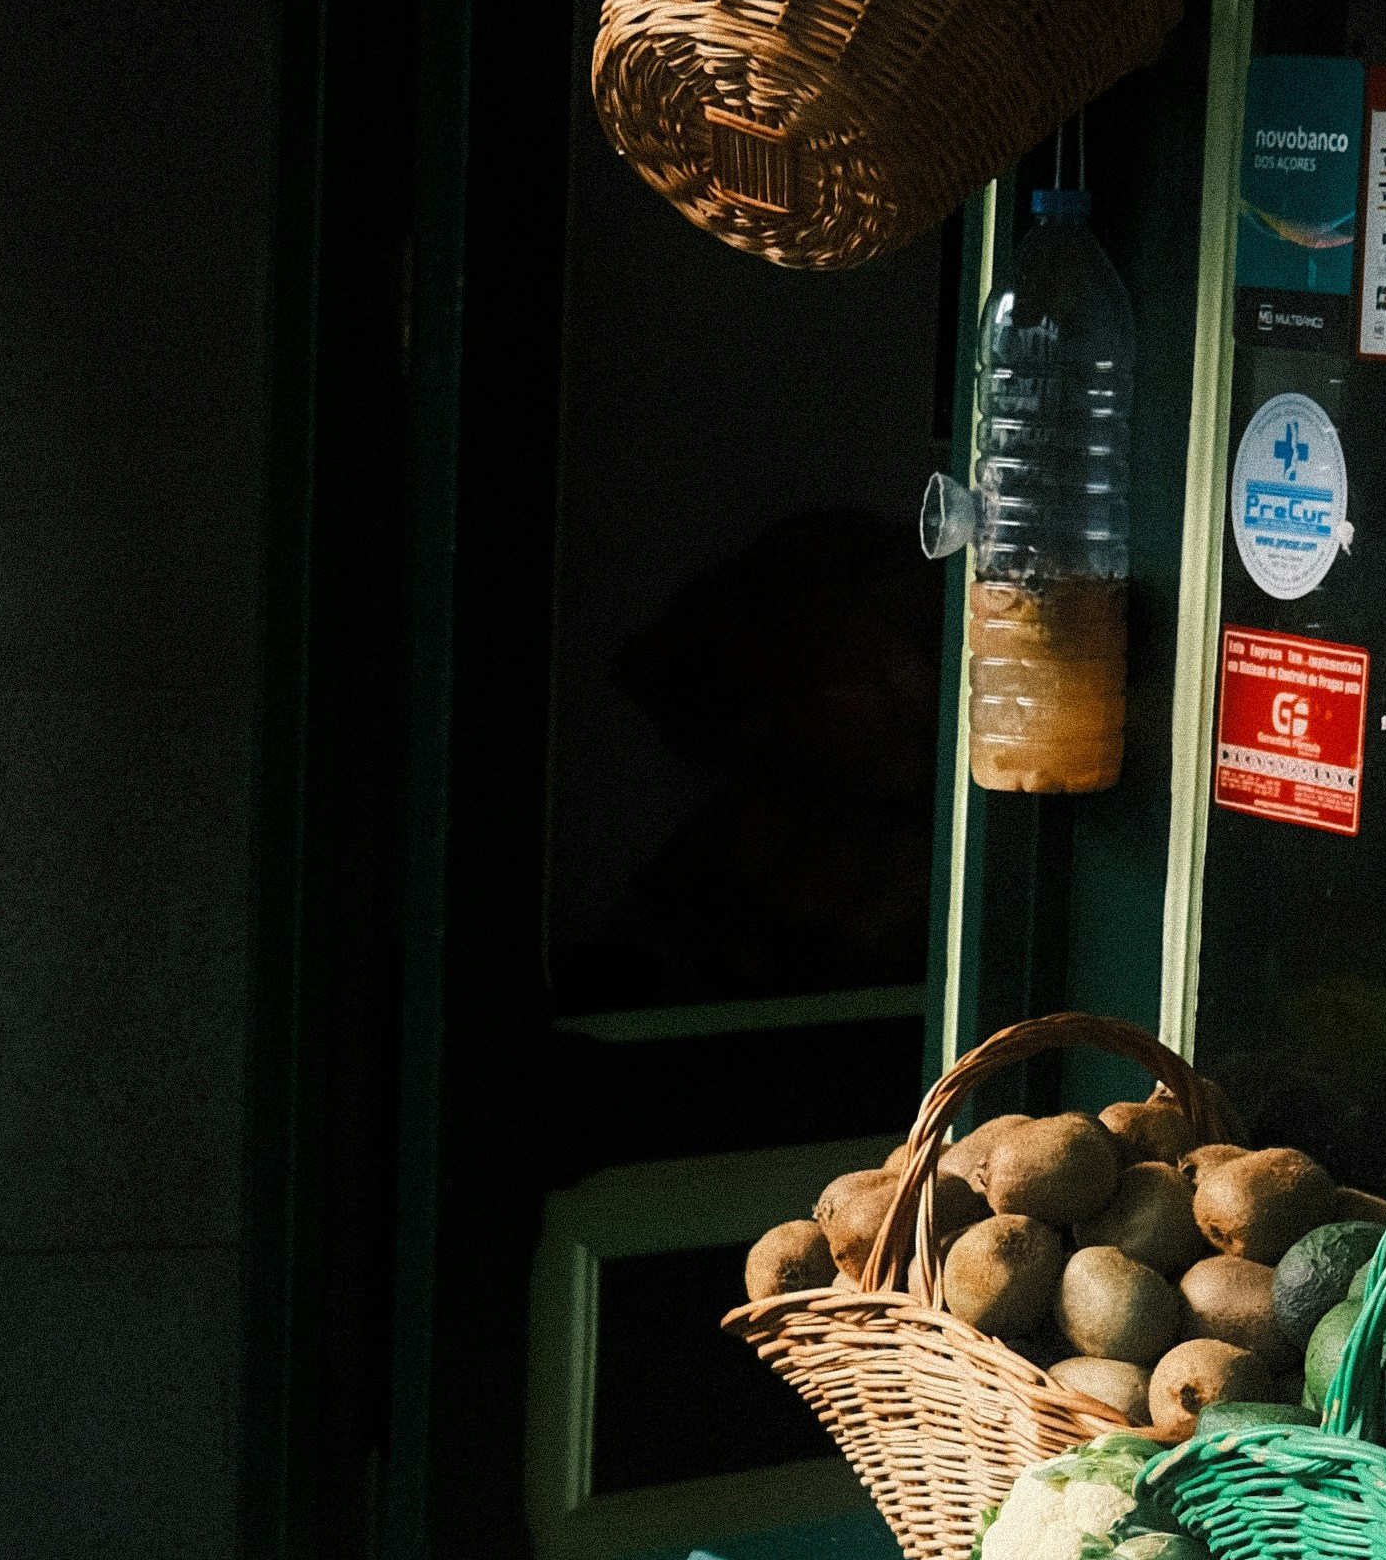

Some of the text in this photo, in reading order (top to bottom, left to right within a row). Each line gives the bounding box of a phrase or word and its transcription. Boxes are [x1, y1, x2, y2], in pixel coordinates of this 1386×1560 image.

[1255, 125, 1349, 154] novobanco
[1254, 155, 1317, 173] DOS AÇORES
